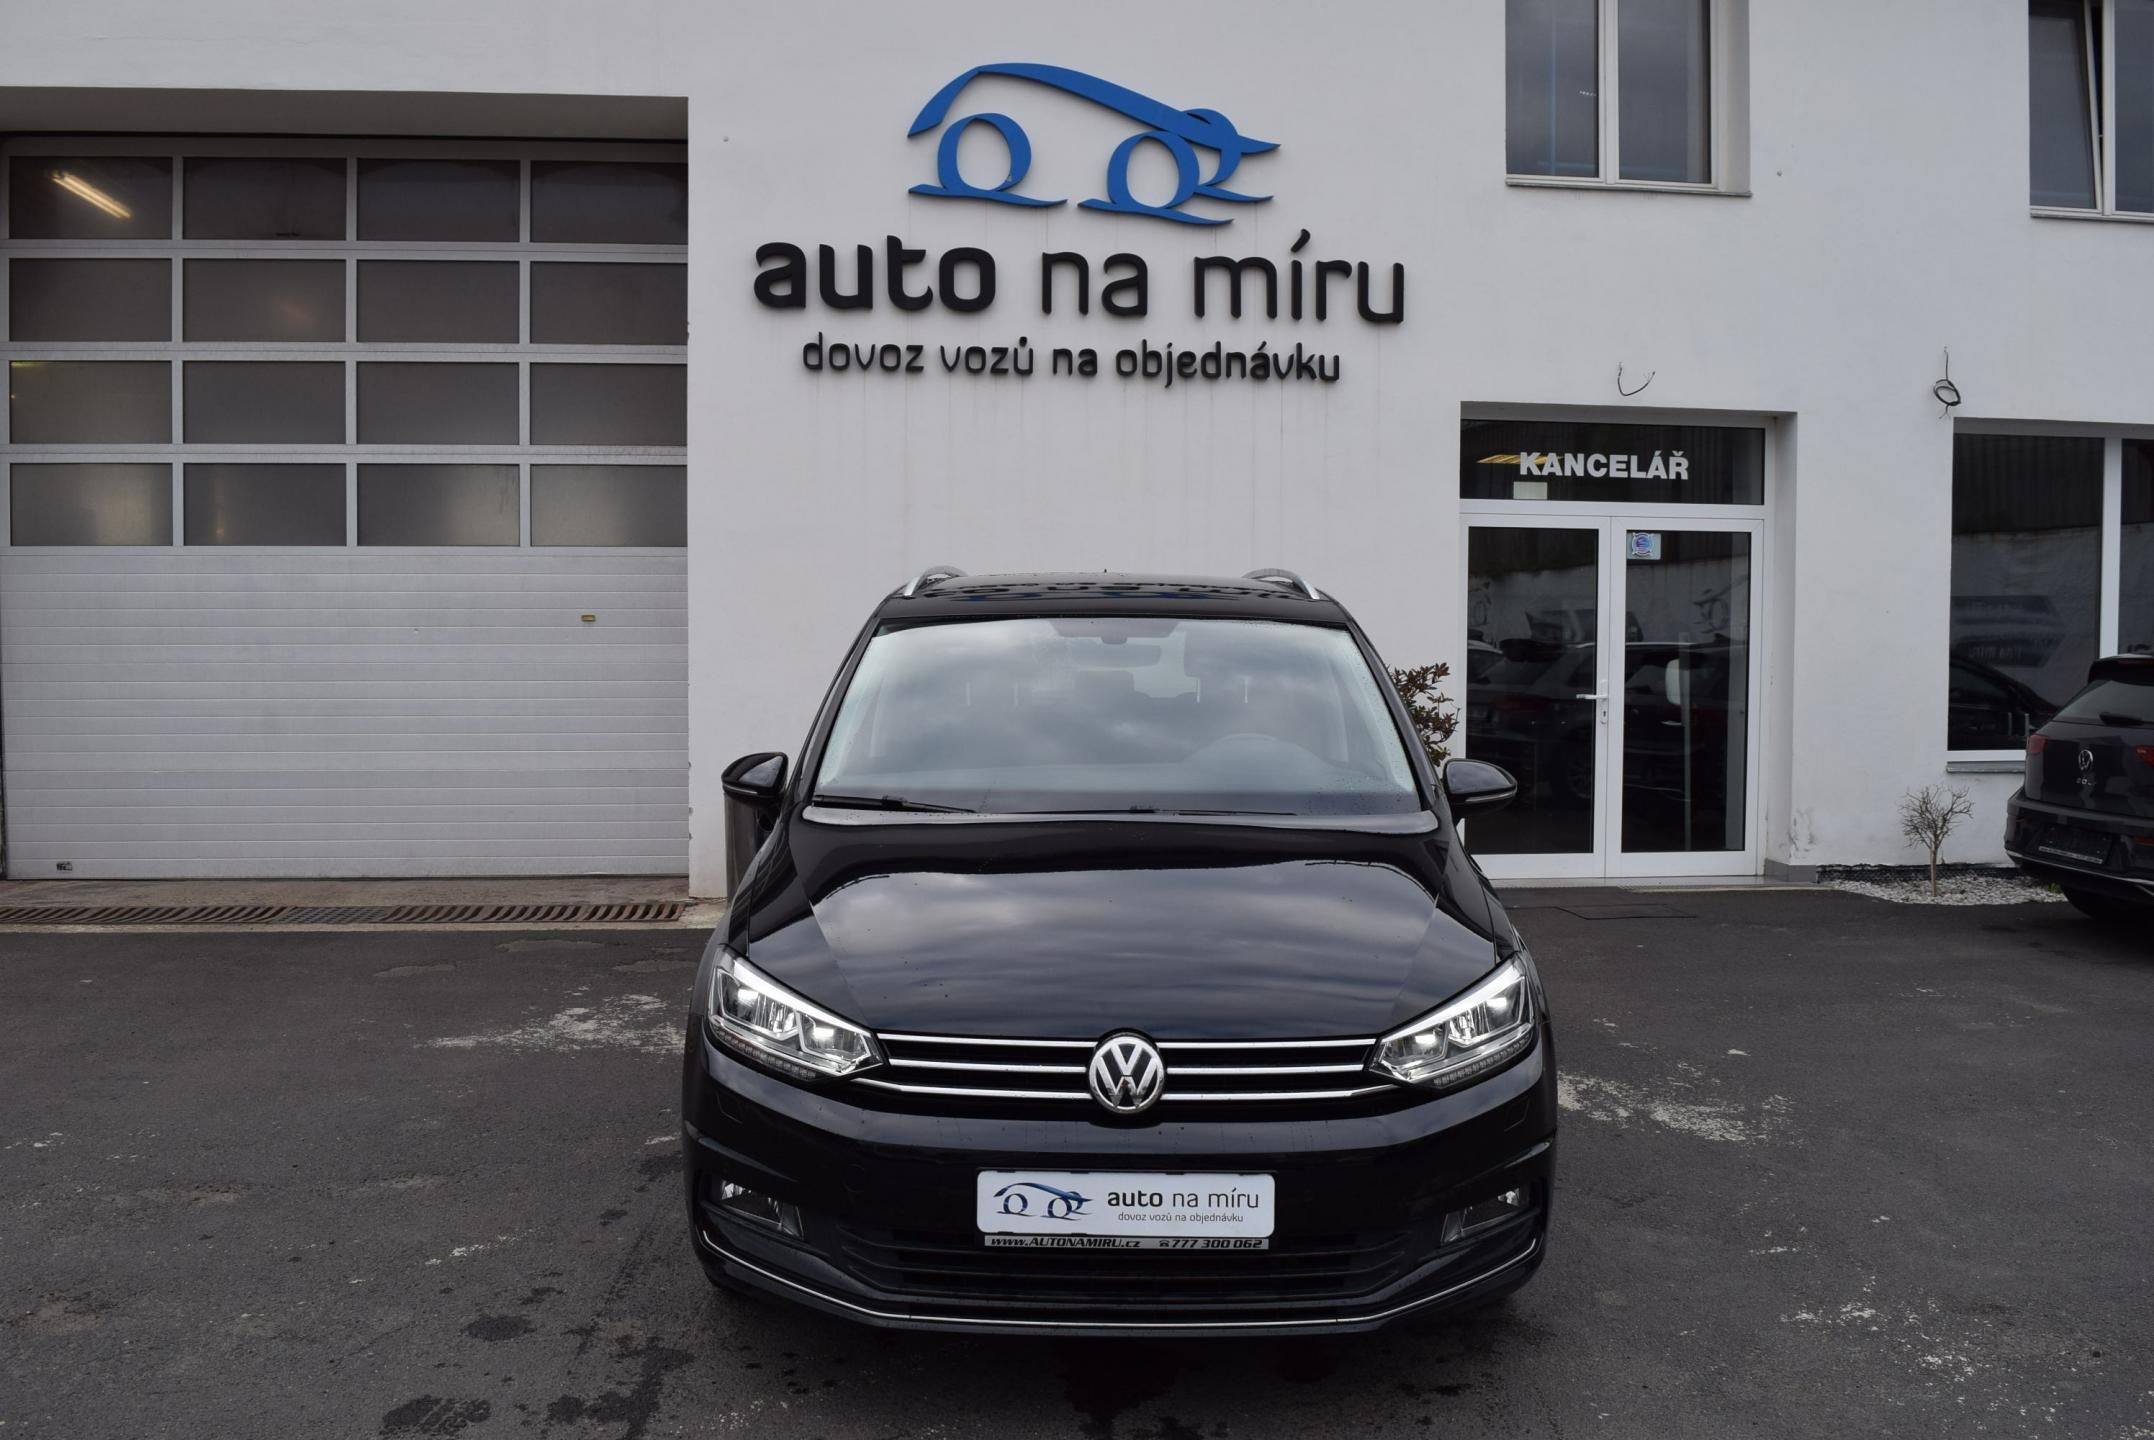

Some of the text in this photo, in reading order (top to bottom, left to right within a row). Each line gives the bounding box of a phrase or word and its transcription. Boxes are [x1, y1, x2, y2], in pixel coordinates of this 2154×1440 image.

[753, 228, 1405, 324] auto na míru
[802, 331, 1340, 388] dovoz vozů na objednávku
[1520, 450, 1689, 480] KANCELÁŘ
[1107, 1188, 1259, 1208] auto na míru
[1118, 1211, 1244, 1225] dovoz vozů na objednávku
[1171, 1239, 1200, 1249] 777
[1202, 1239, 1232, 1249] 300
[1233, 1239, 1263, 1249] 062
